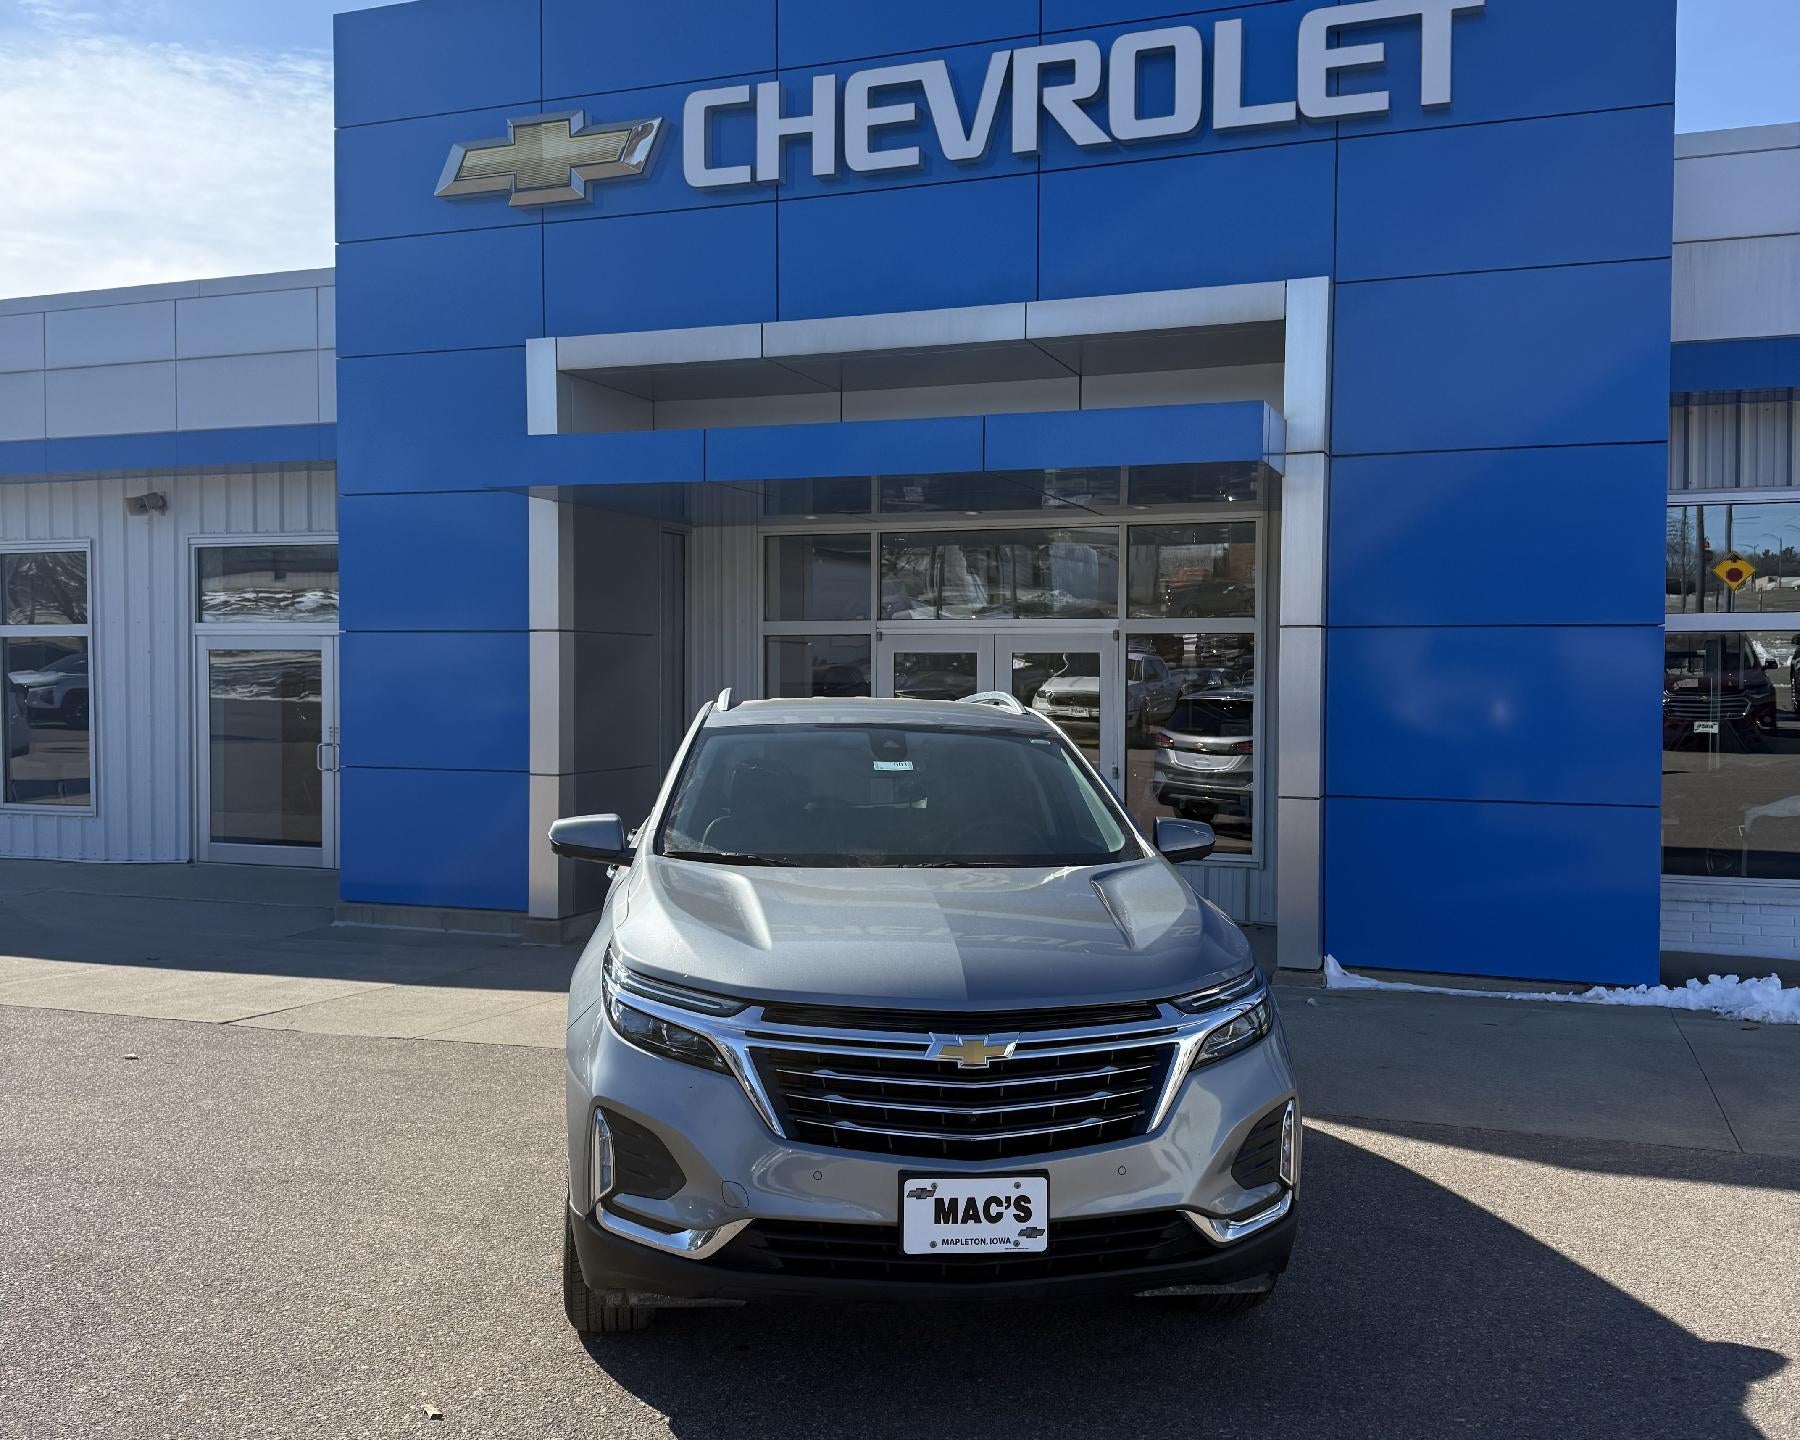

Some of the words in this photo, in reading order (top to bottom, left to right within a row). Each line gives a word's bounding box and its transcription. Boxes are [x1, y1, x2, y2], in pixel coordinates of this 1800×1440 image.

[683, 0, 1486, 188] CHEVROLET
[933, 1195, 1033, 1224] MAC'S
[989, 1237, 1011, 1245] IOWA
